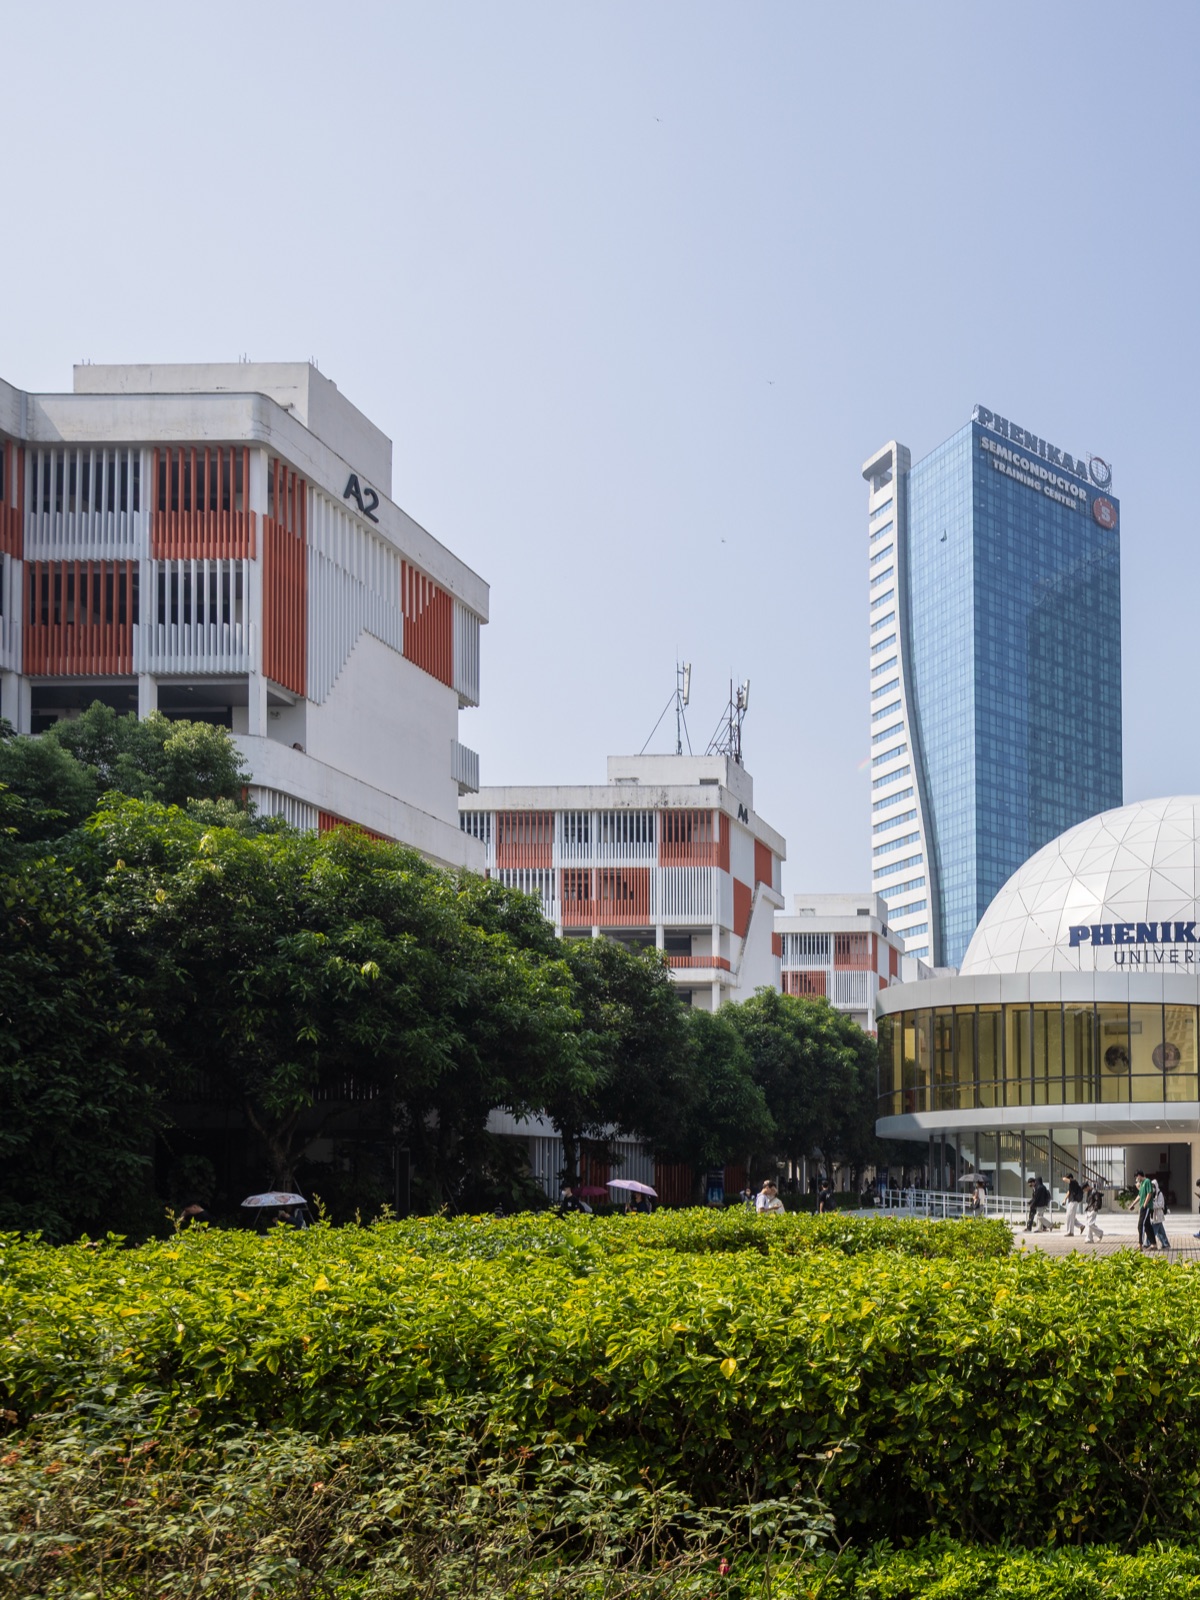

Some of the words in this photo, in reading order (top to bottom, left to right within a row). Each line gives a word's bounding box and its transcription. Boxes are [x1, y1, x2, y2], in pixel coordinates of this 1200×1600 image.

[977, 404, 1089, 480] PHENIKAA
[980, 436, 1087, 501] SEMICONDUCTOR
[343, 473, 379, 523] A2
[993, 458, 1041, 491] TRAINING
[1043, 485, 1077, 510] CENTER
